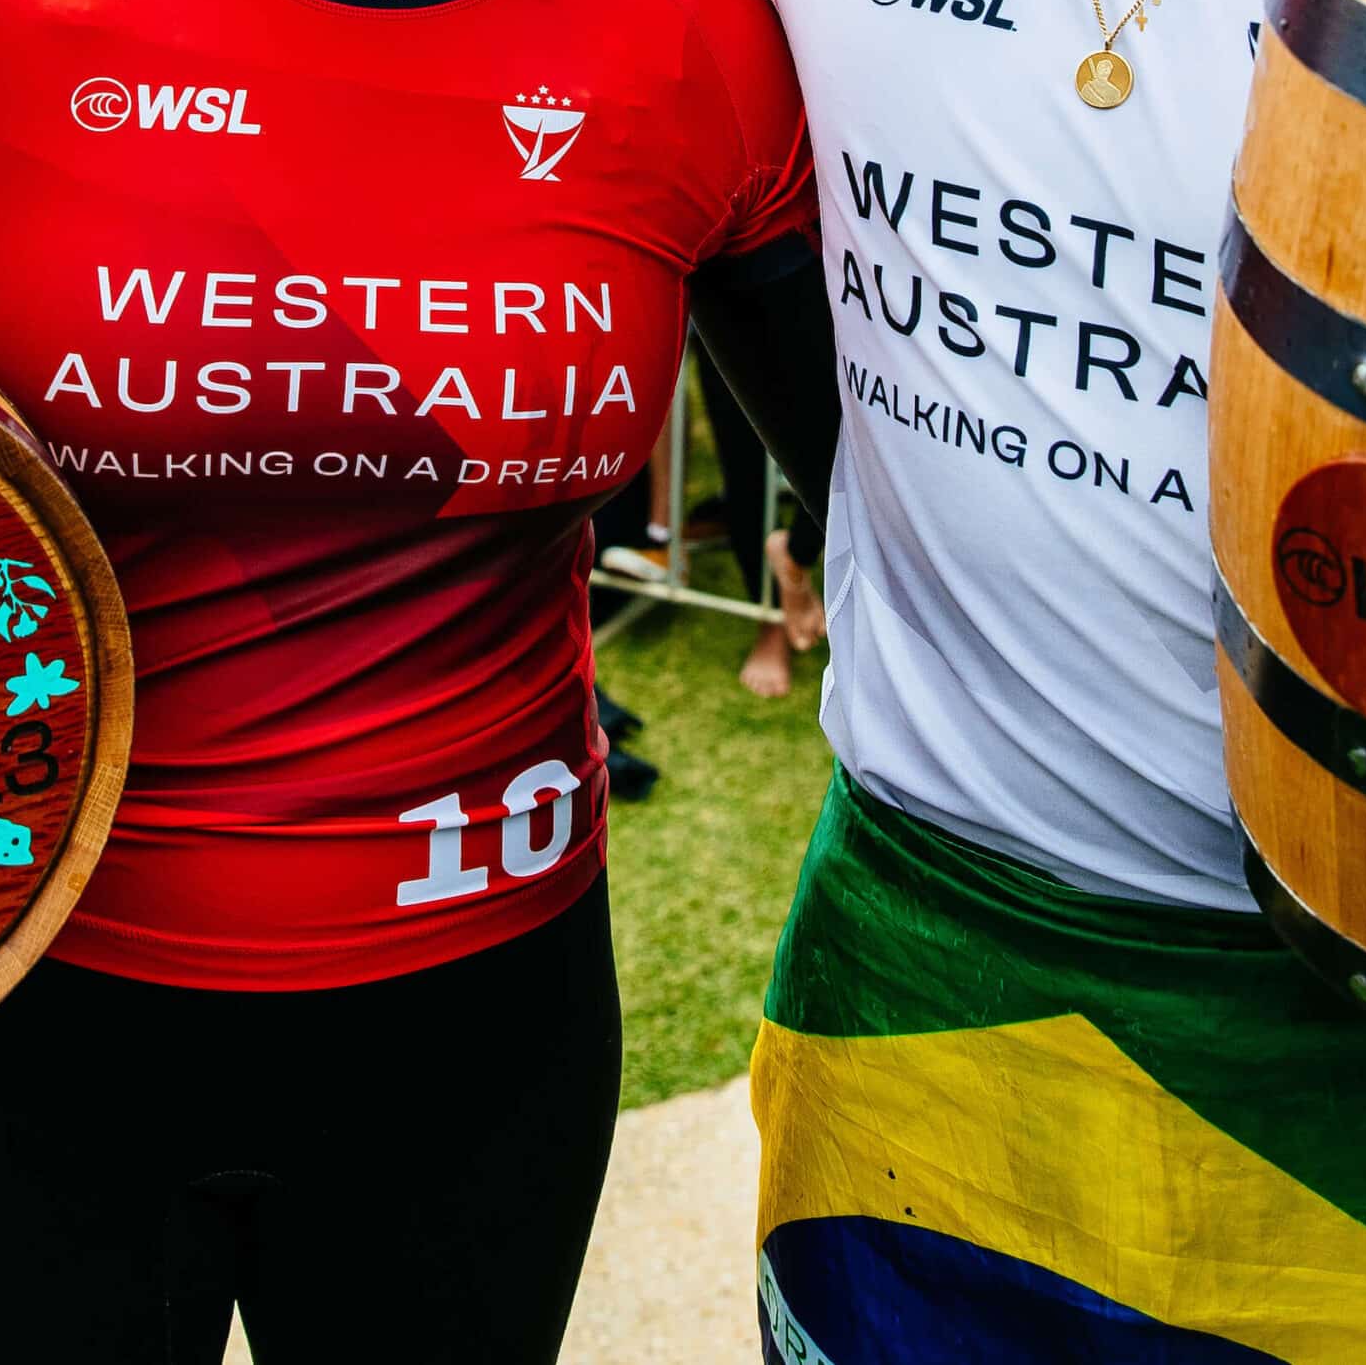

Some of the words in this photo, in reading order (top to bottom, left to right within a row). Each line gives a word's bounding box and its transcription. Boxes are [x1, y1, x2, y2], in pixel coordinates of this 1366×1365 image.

[137, 83, 263, 135] WSL
[841, 150, 1207, 318] WESTE
[96, 265, 613, 335] WESTERN
[840, 248, 1209, 408] AUSTRA
[43, 351, 637, 421] AUSTRALIA
[842, 353, 1028, 468] WALKING
[1046, 439, 1131, 495] ON
[1149, 467, 1195, 513] A
[47, 440, 293, 480] WALKING
[312, 450, 388, 479] ON
[403, 455, 442, 482] A
[456, 451, 626, 486] DREAM
[396, 758, 582, 907] 10
